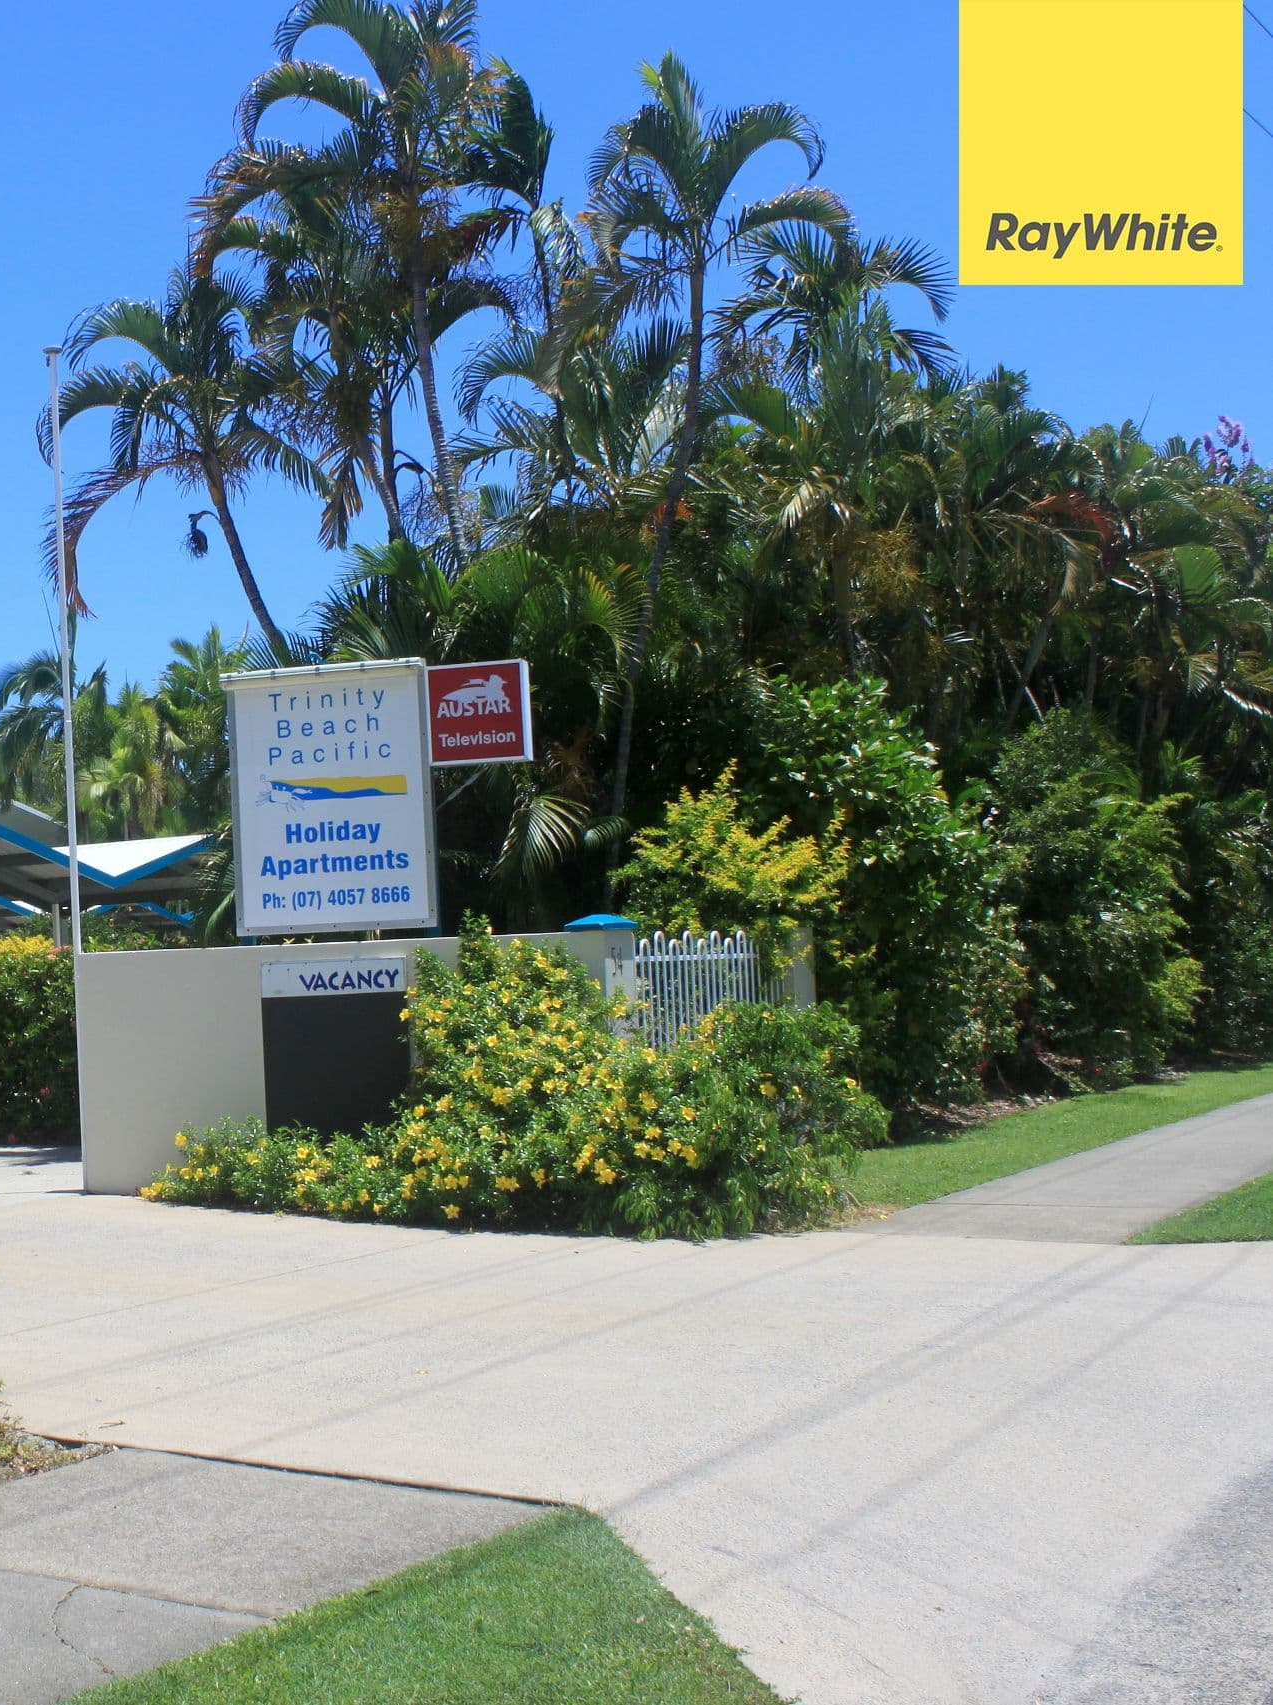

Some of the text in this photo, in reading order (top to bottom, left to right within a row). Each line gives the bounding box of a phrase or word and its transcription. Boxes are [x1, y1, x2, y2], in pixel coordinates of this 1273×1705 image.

[268, 687, 385, 712] Trinity
[436, 697, 512, 719] AUSTAR
[277, 713, 379, 738] Beach
[438, 730, 516, 748] Television
[268, 740, 391, 766] Pacific
[285, 820, 381, 845] Holiday
[260, 849, 409, 880] Apartments
[262, 885, 410, 912] Ph: (07) 4057 8666
[299, 968, 400, 992] VACANCY
